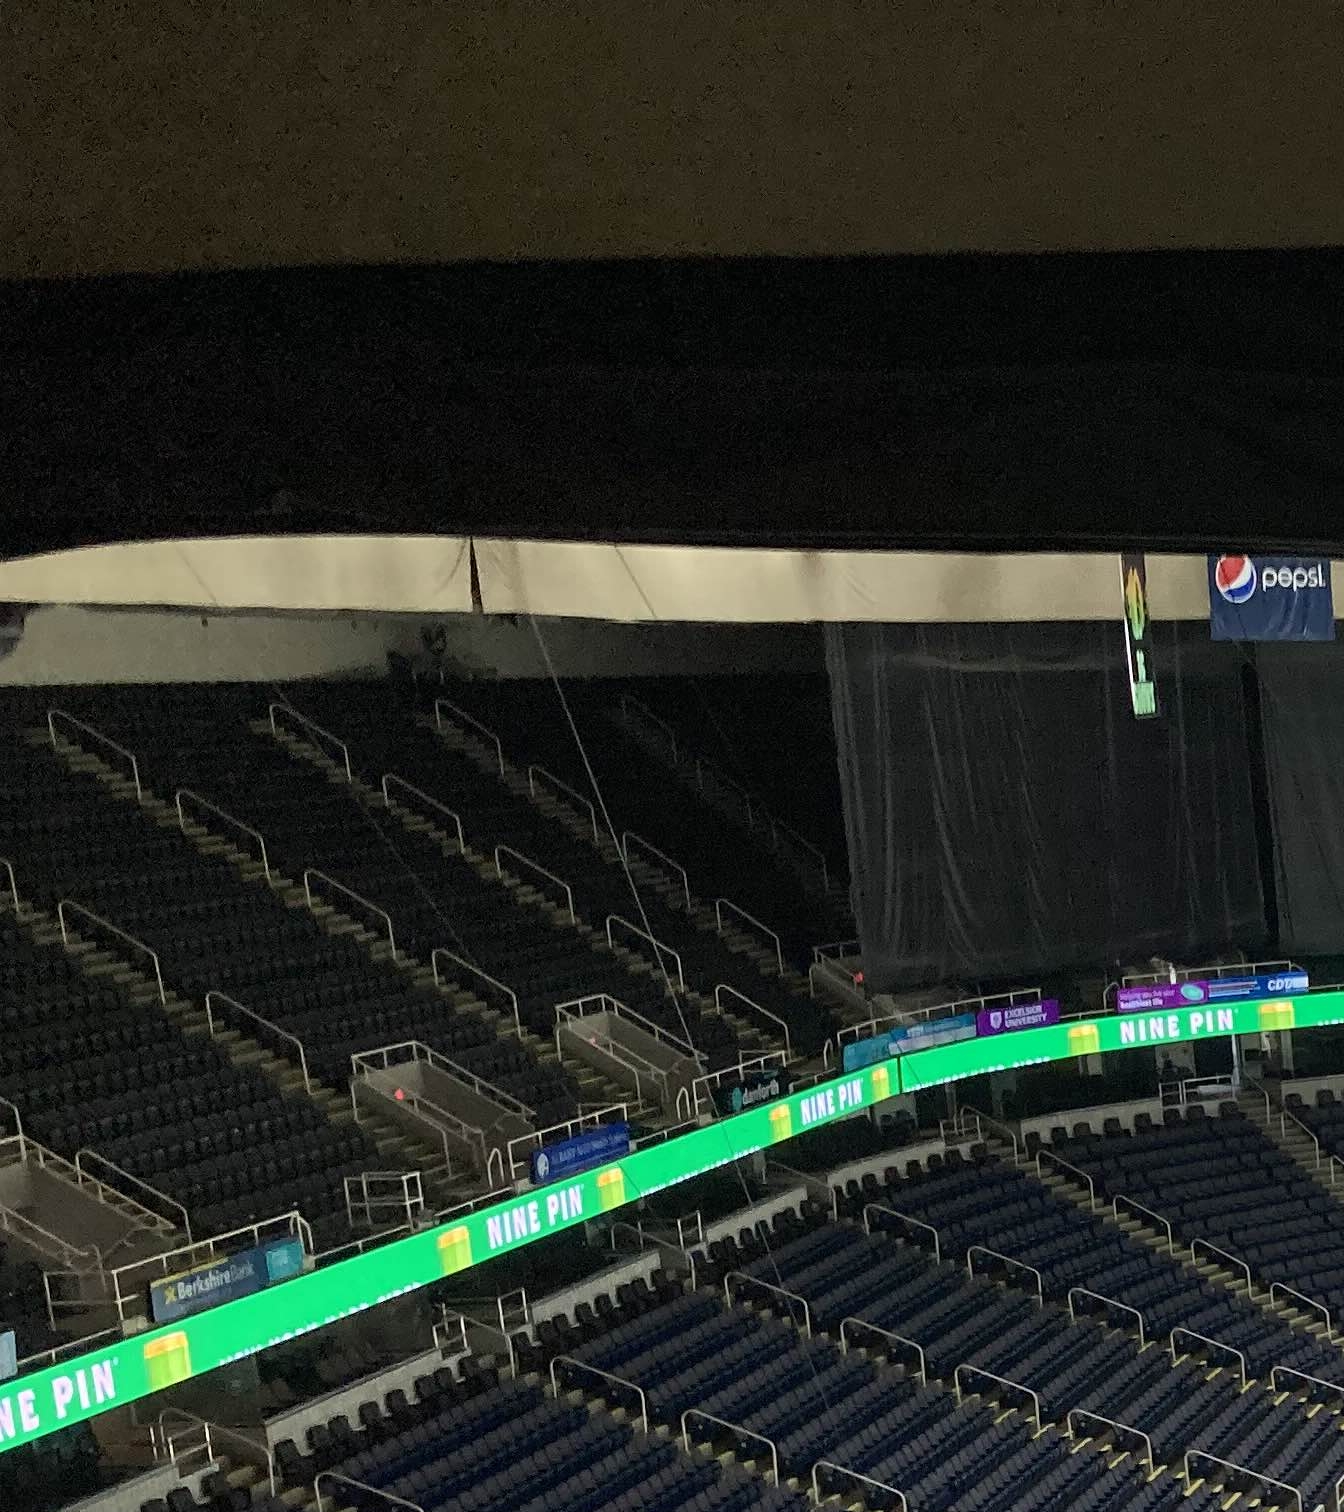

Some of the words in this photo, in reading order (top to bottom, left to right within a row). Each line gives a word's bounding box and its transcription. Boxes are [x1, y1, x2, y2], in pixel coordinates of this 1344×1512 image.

[1262, 563, 1321, 592] pepsi
[1120, 1015, 1180, 1044] NINE
[1190, 1008, 1233, 1034] PIN
[800, 1088, 835, 1125] NINE
[838, 1079, 863, 1111] PIN
[487, 1200, 541, 1250] NINE
[546, 1185, 583, 1226] PIN
[177, 1269, 231, 1299] Berkshire
[0, 1388, 40, 1442] NE
[52, 1359, 116, 1420] PIN
